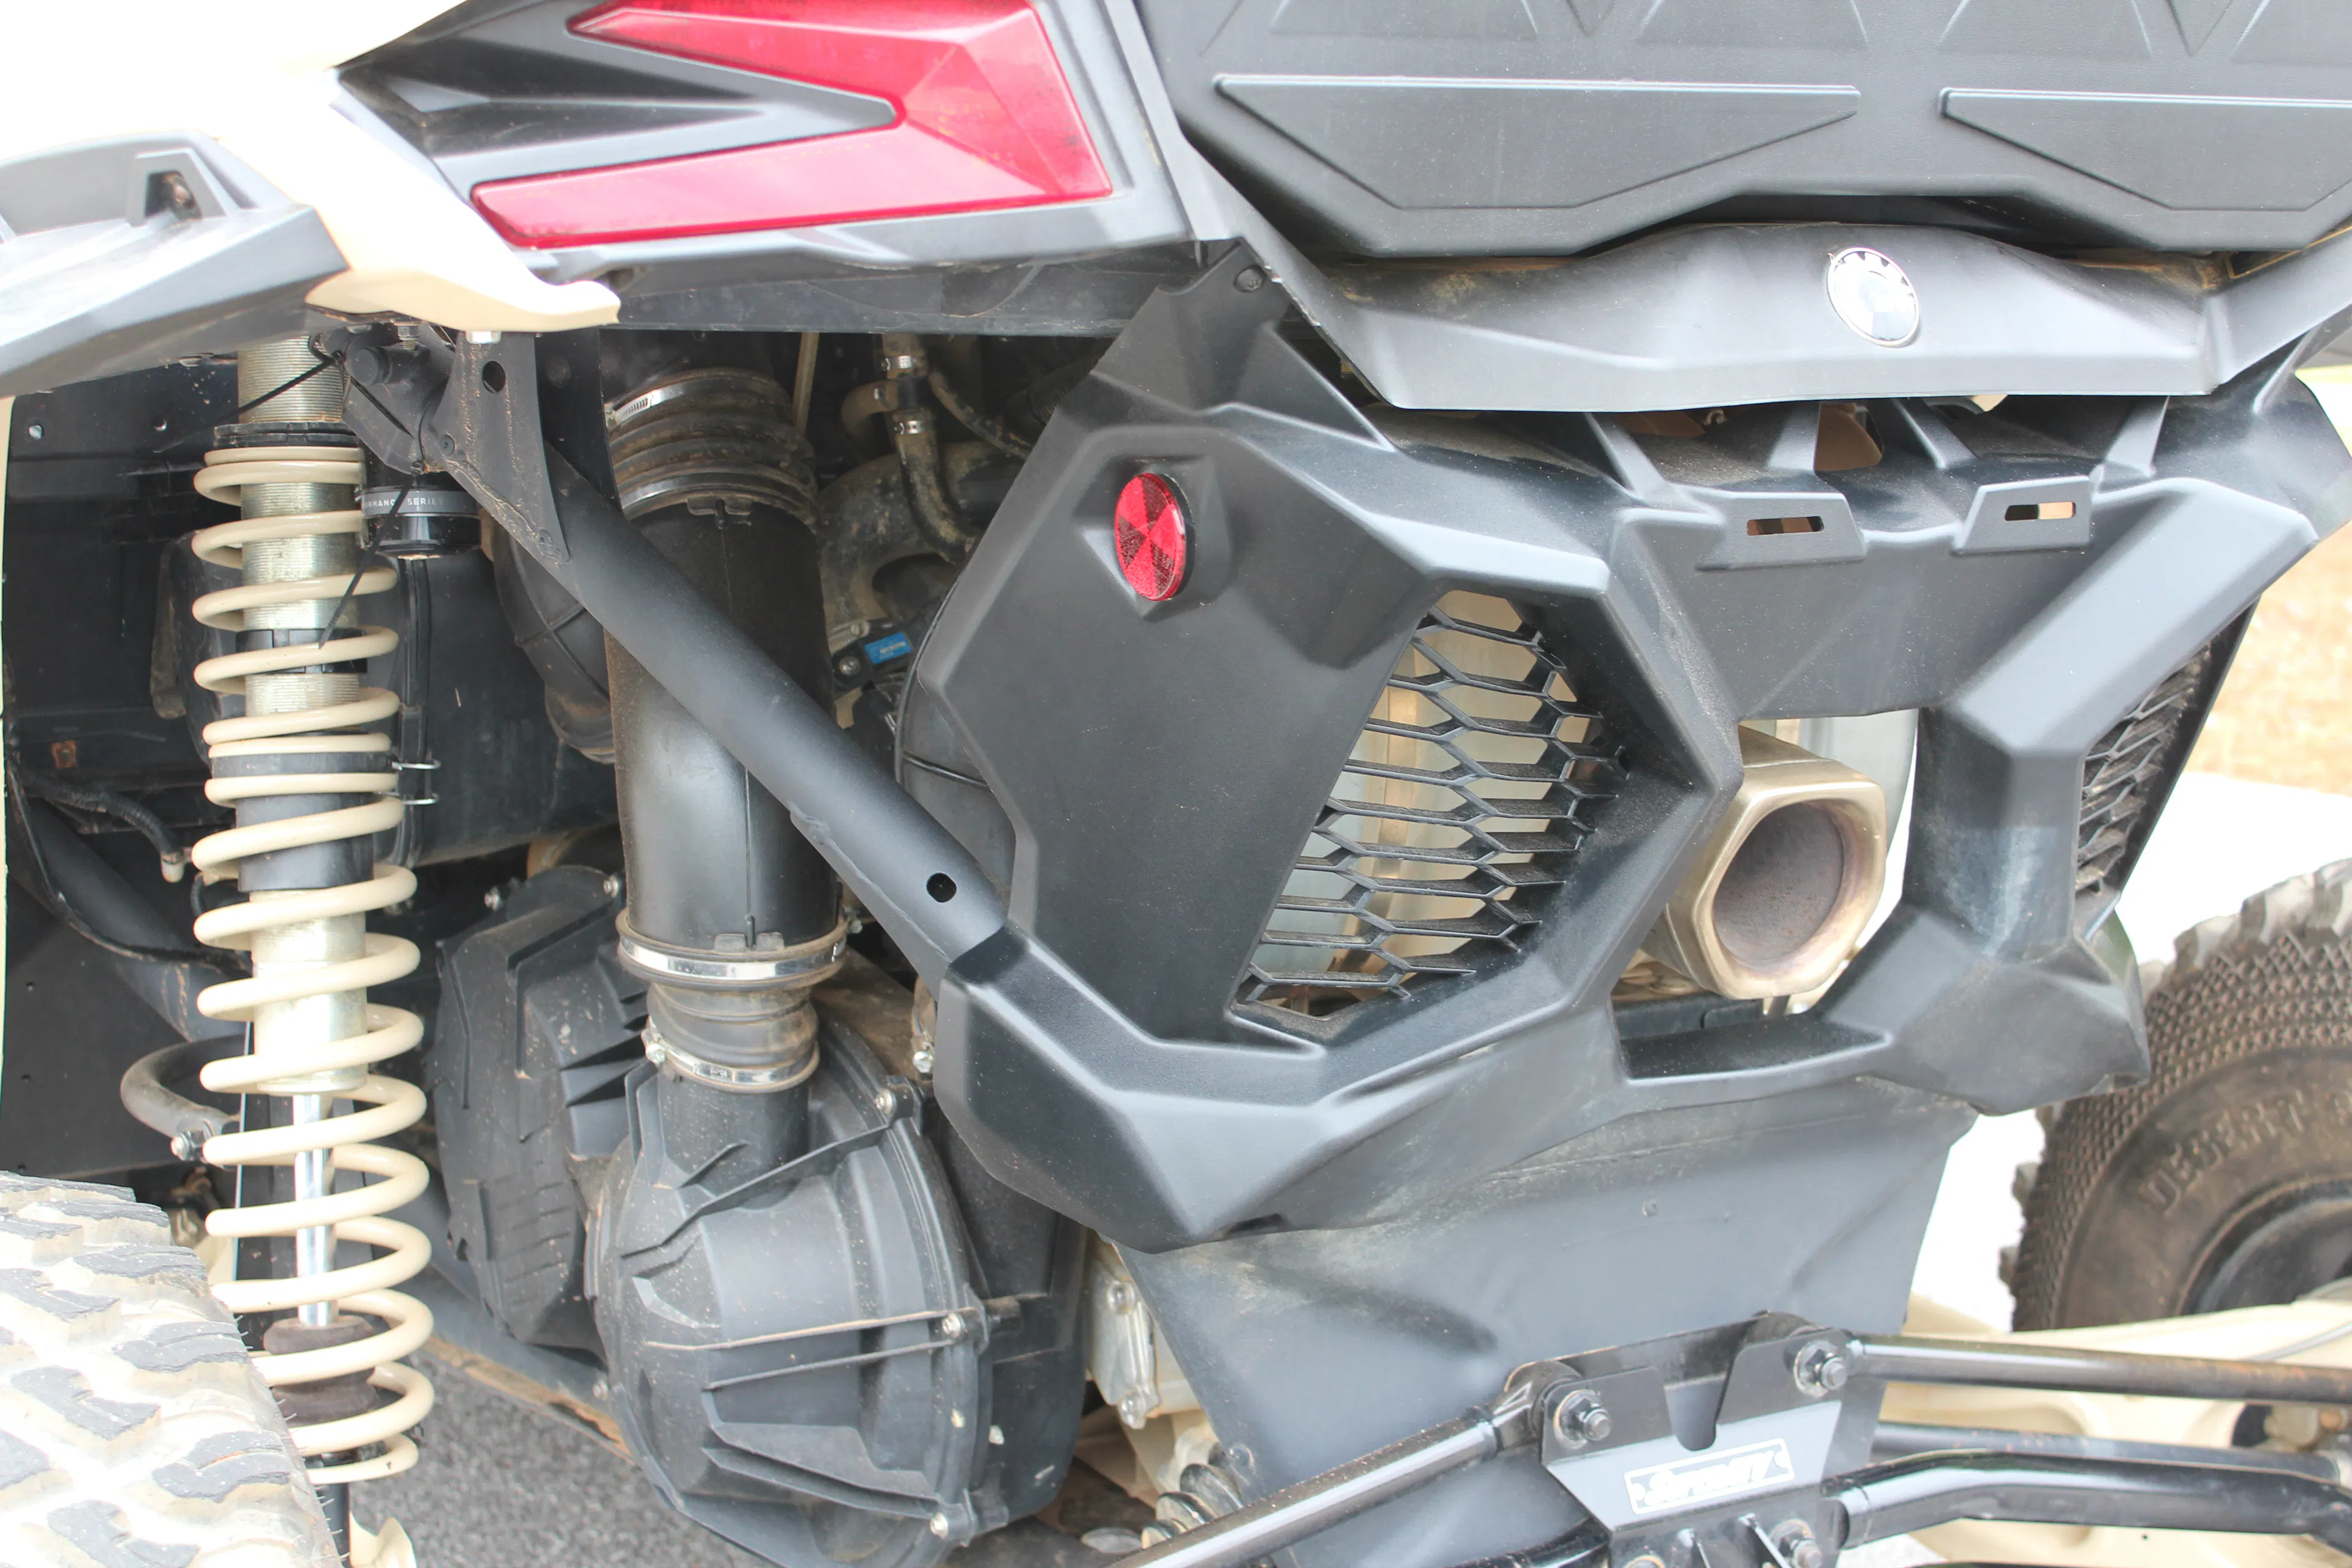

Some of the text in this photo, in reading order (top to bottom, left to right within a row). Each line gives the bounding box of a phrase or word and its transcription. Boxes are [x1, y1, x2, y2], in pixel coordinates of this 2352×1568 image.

[365, 497, 443, 508] ORMANC SERIES
[2139, 1089, 2307, 1219] DESERT
